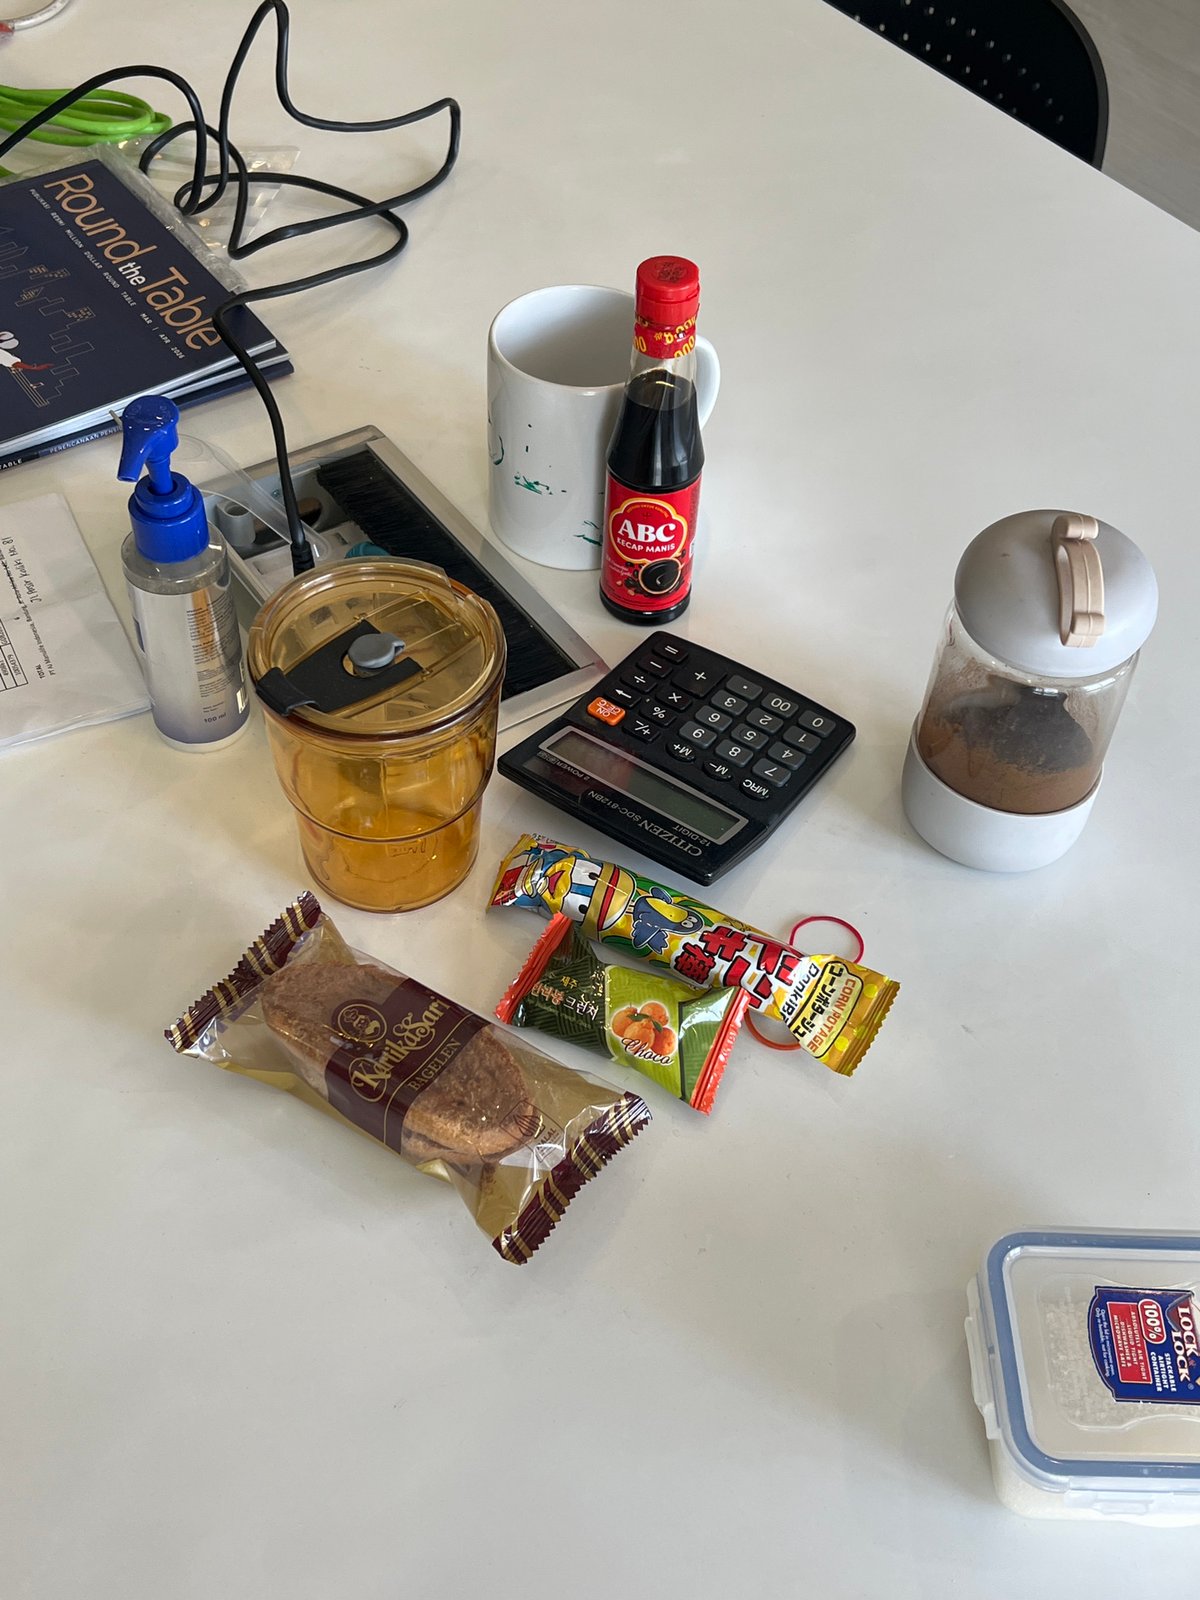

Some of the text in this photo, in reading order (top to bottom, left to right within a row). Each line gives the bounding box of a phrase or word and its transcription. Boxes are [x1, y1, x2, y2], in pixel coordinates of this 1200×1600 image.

[44, 173, 222, 350] Round the Table
[50, 212, 65, 227] RESMI
[65, 229, 85, 249] MILLION
[84, 251, 103, 270] DOLLAR
[103, 271, 120, 289] ROUND
[121, 291, 137, 307] TABLE
[140, 313, 153, 325] MAR
[159, 333, 171, 345] APR
[50, 433, 99, 454] PERENCANAAN
[618, 519, 676, 542] ABC
[617, 537, 676, 553] KECAP MANIS
[35, 664, 46, 679] TOTAL
[724, 697, 736, 707] 3
[771, 697, 791, 712] 00
[708, 712, 720, 723] 6
[760, 715, 772, 725] 2
[812, 717, 823, 727] 0
[692, 728, 705, 739] 9
[746, 730, 757, 741] 5
[797, 733, 807, 743] 1
[673, 743, 692, 757] M+
[728, 746, 741, 757] 8
[781, 750, 793, 759] 4
[556, 762, 583, 778] POWER
[764, 766, 778, 777] 7
[742, 779, 770, 797] MRC
[588, 789, 703, 857] CITIZEN SDC-812BN
[672, 824, 711, 847] 12-DIGIT
[560, 975, 578, 989] 제주
[563, 996, 599, 1020] 크런치
[792, 964, 844, 1038] コーンポタージュ
[808, 978, 856, 1052] CORN POTAGE
[622, 1037, 674, 1065] Choco
[349, 1031, 419, 1102] Kartika
[407, 1038, 461, 1090] BAGELEN
[1113, 1314, 1123, 1350] MICROWAVE
[1143, 1304, 1163, 1339] 100%
[1178, 1306, 1200, 1356] LOCK
[1171, 1330, 1190, 1382] LOCK
[1150, 1352, 1162, 1392] CONTAINER
[1157, 1355, 1169, 1389] AIRTIGHT
[1164, 1352, 1177, 1392] STACKABLE
